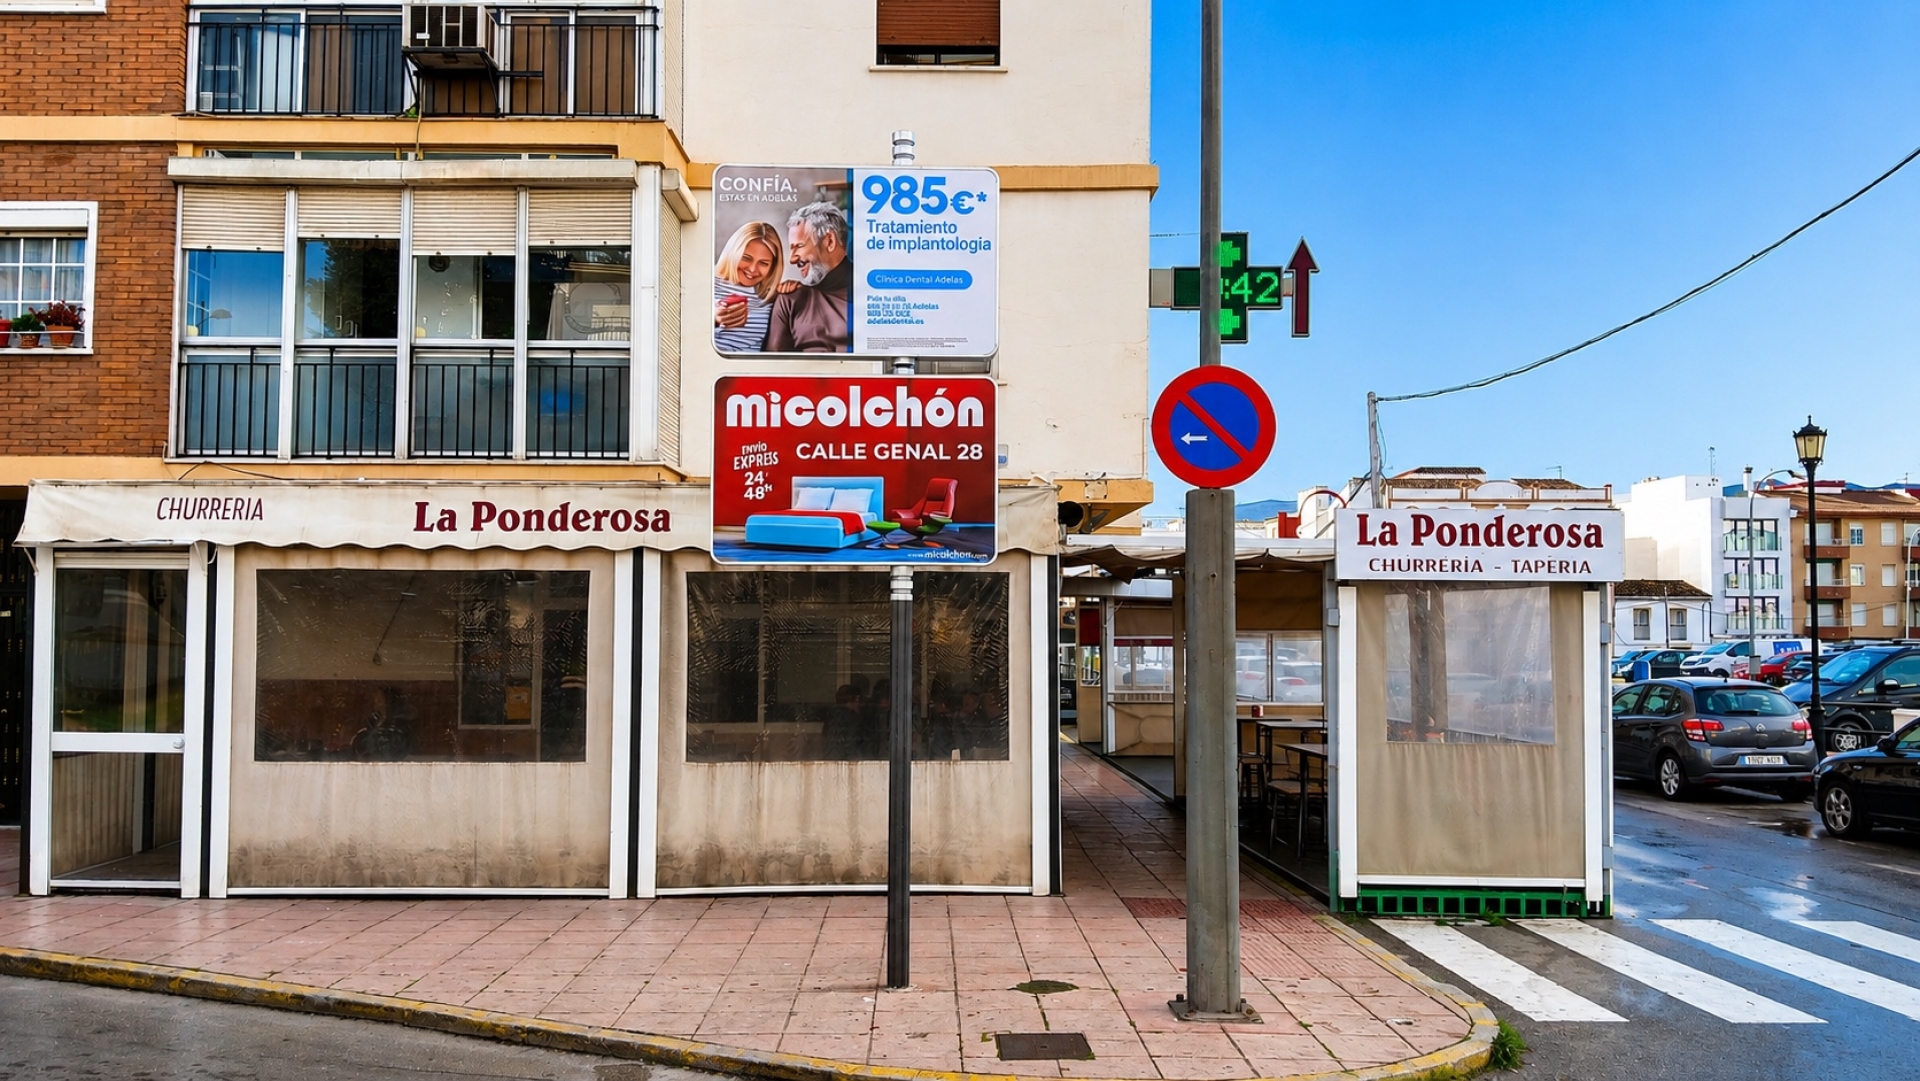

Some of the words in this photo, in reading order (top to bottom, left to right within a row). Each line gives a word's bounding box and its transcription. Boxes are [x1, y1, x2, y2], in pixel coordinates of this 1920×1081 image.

[719, 174, 798, 193] CONFÍA.
[866, 219, 958, 234] Tratamiento
[867, 237, 885, 250] de
[905, 275, 933, 284] Dental
[934, 276, 963, 285] Adelas
[726, 385, 984, 428] micolchón
[796, 443, 867, 460] CALLE
[874, 443, 951, 460] GENAL
[957, 443, 983, 460] 28
[157, 497, 263, 521] CHURRERIA
[414, 501, 457, 532] La
[471, 501, 671, 532] Ponderosa
[1357, 513, 1398, 546] La
[1411, 514, 1604, 548] Ponderosa
